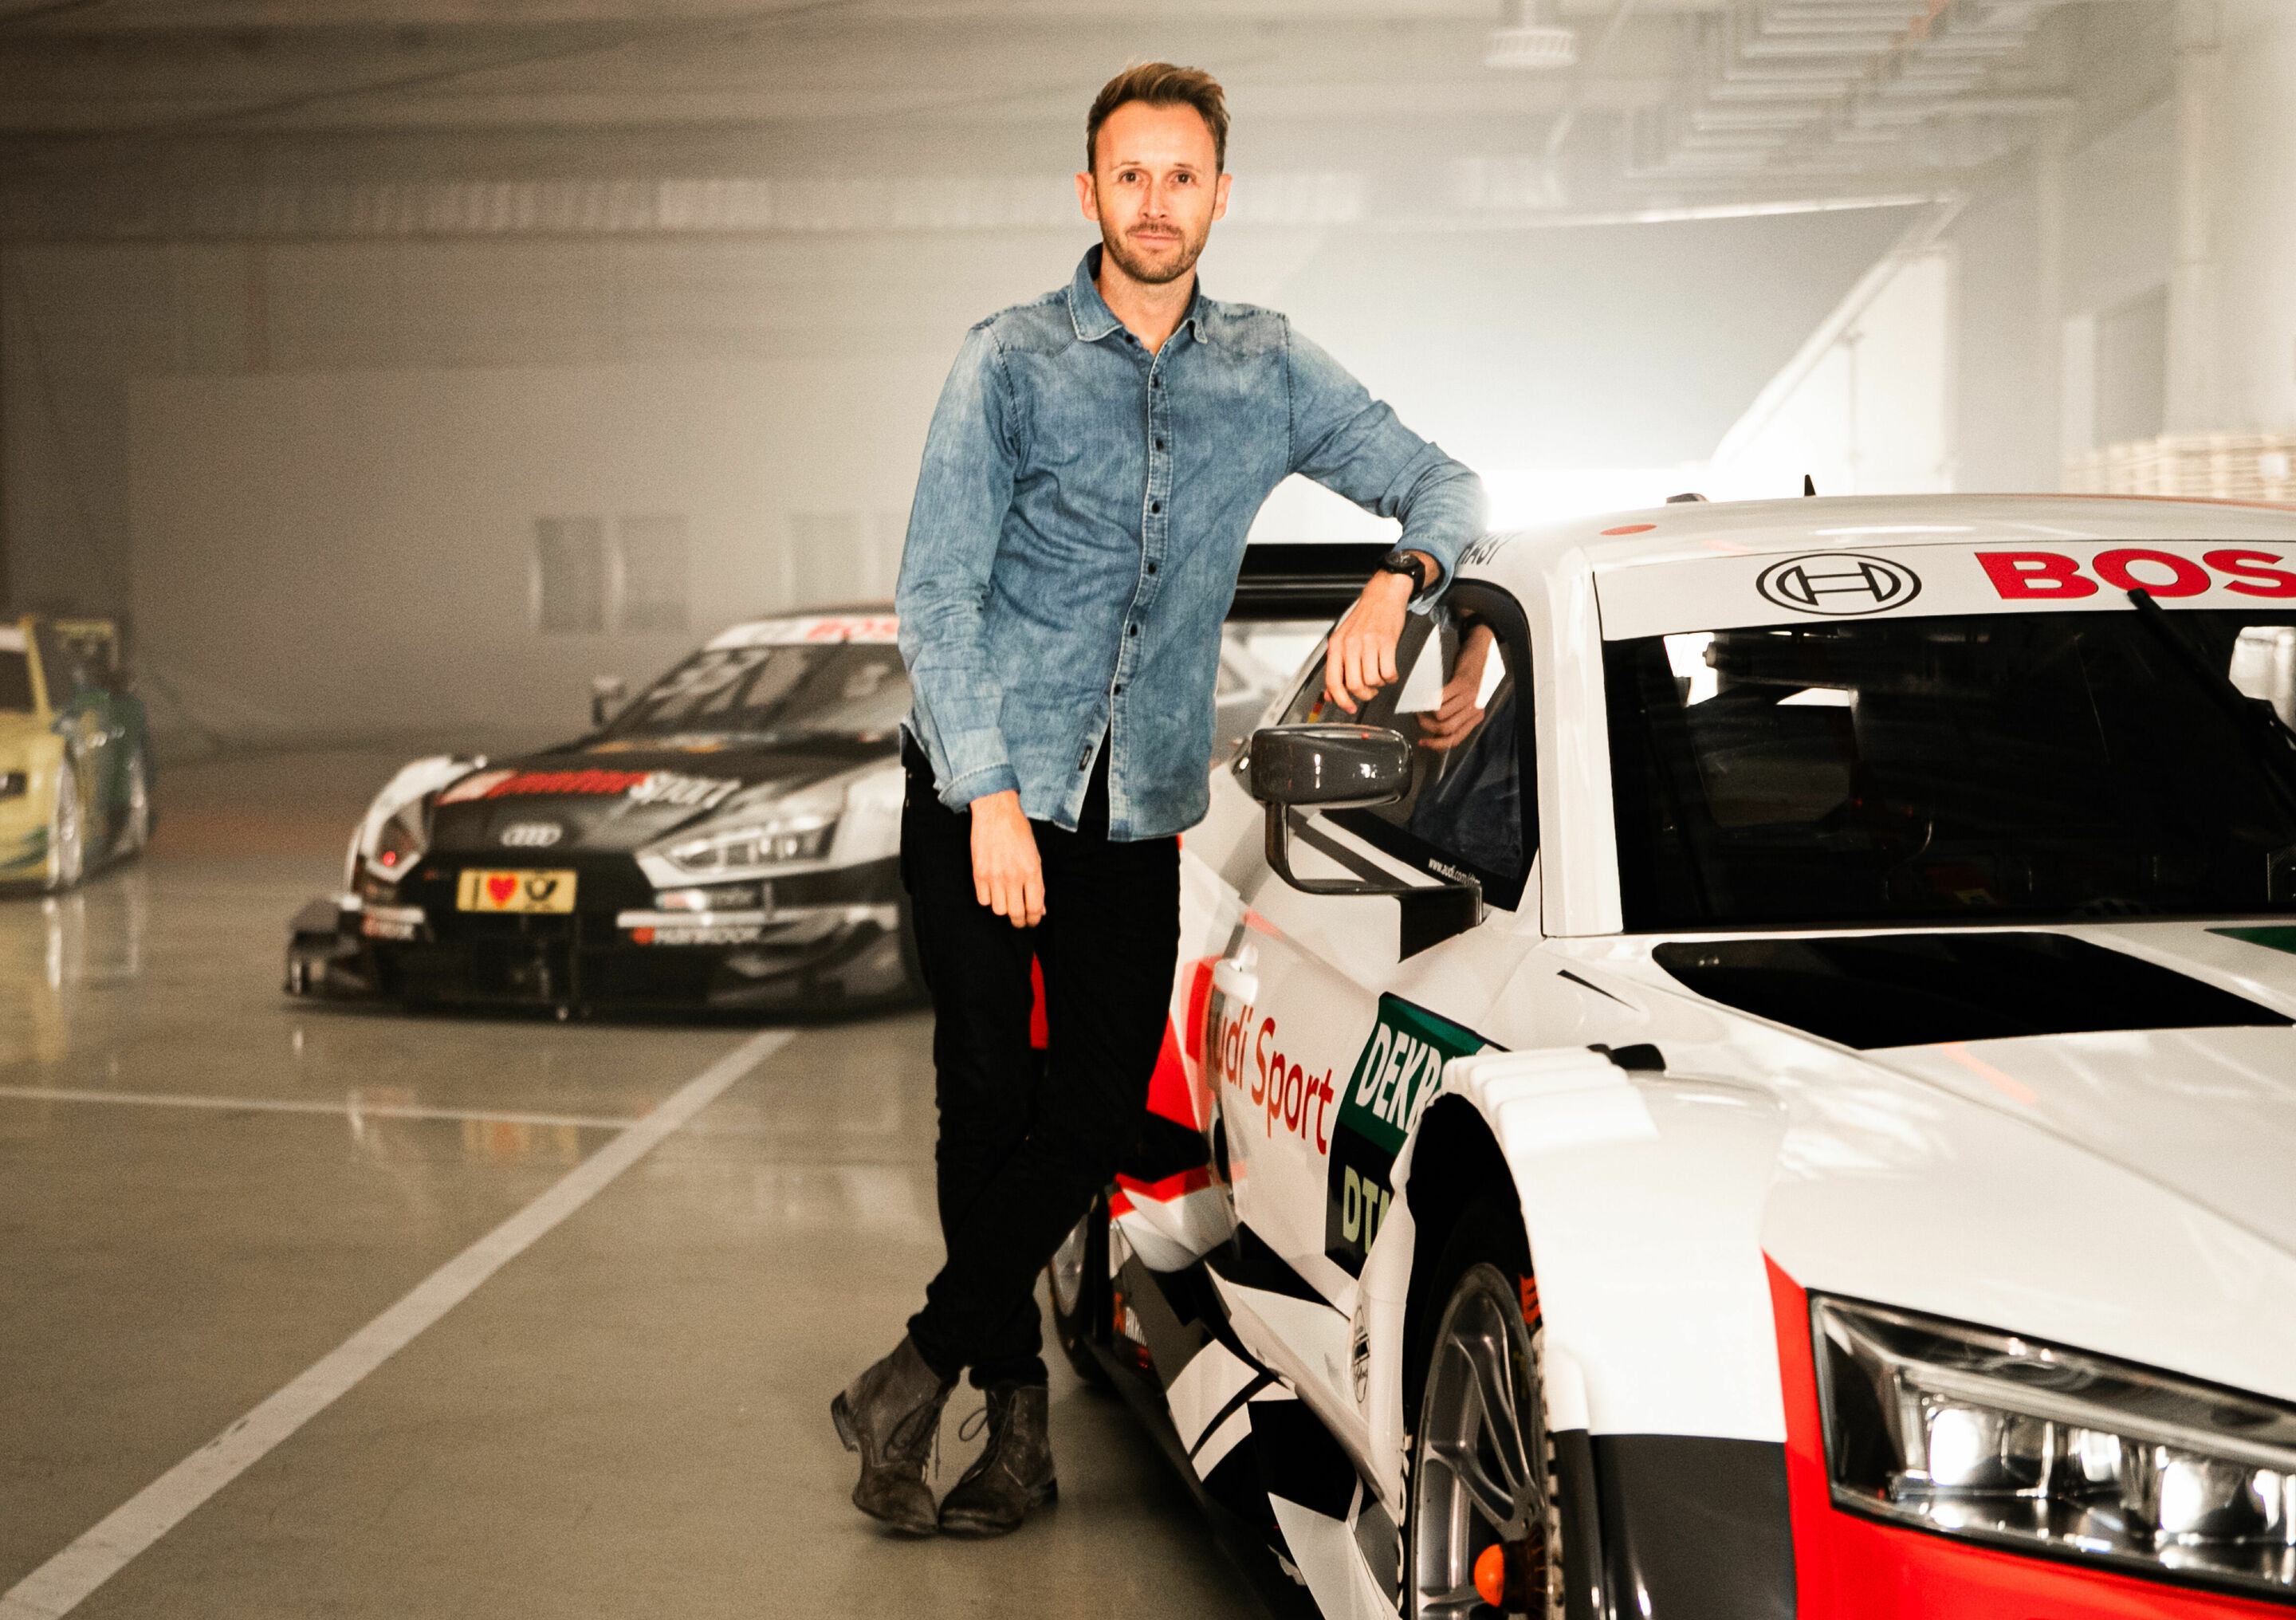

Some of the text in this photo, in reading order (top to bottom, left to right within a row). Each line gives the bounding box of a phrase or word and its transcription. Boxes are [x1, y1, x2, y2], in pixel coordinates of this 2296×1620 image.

[1215, 1005, 1334, 1156] udi Sport
[1355, 1022, 1456, 1134] DEKR
